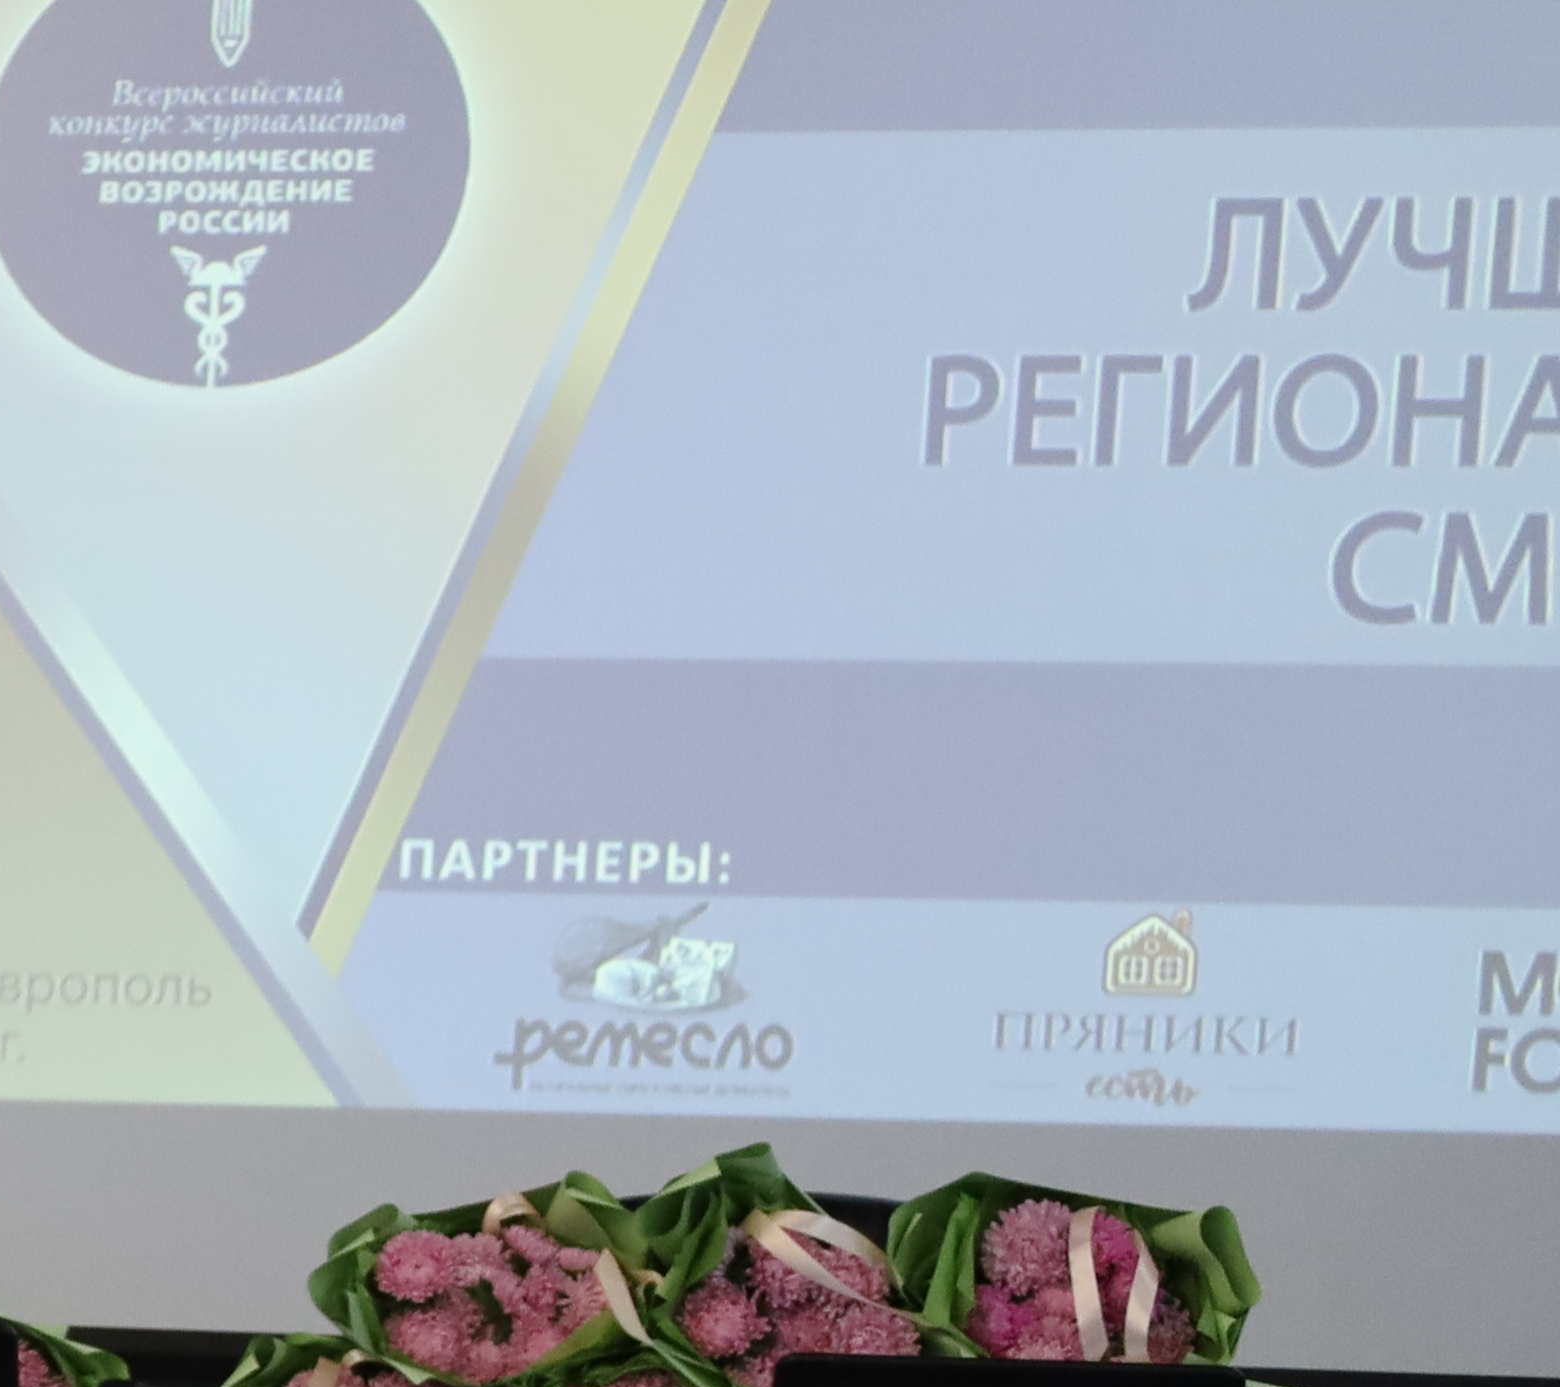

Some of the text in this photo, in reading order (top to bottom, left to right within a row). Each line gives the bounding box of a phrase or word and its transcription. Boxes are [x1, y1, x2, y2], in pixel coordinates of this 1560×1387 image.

[111, 78, 344, 112] Всероссийский
[48, 112, 407, 144] конкурс журналистов
[81, 148, 375, 174] ЭКОНОМИЧЕСКОЕ
[98, 178, 353, 207] ВОЗРОЖДЕНИЕ
[158, 209, 291, 234] РОССИИ
[1331, 510, 1550, 626] СМ
[399, 837, 731, 884] ПАРТНЕРЫ:
[0, 1029, 26, 1064] г.
[992, 1011, 1300, 1056] ПРЯНИКИ
